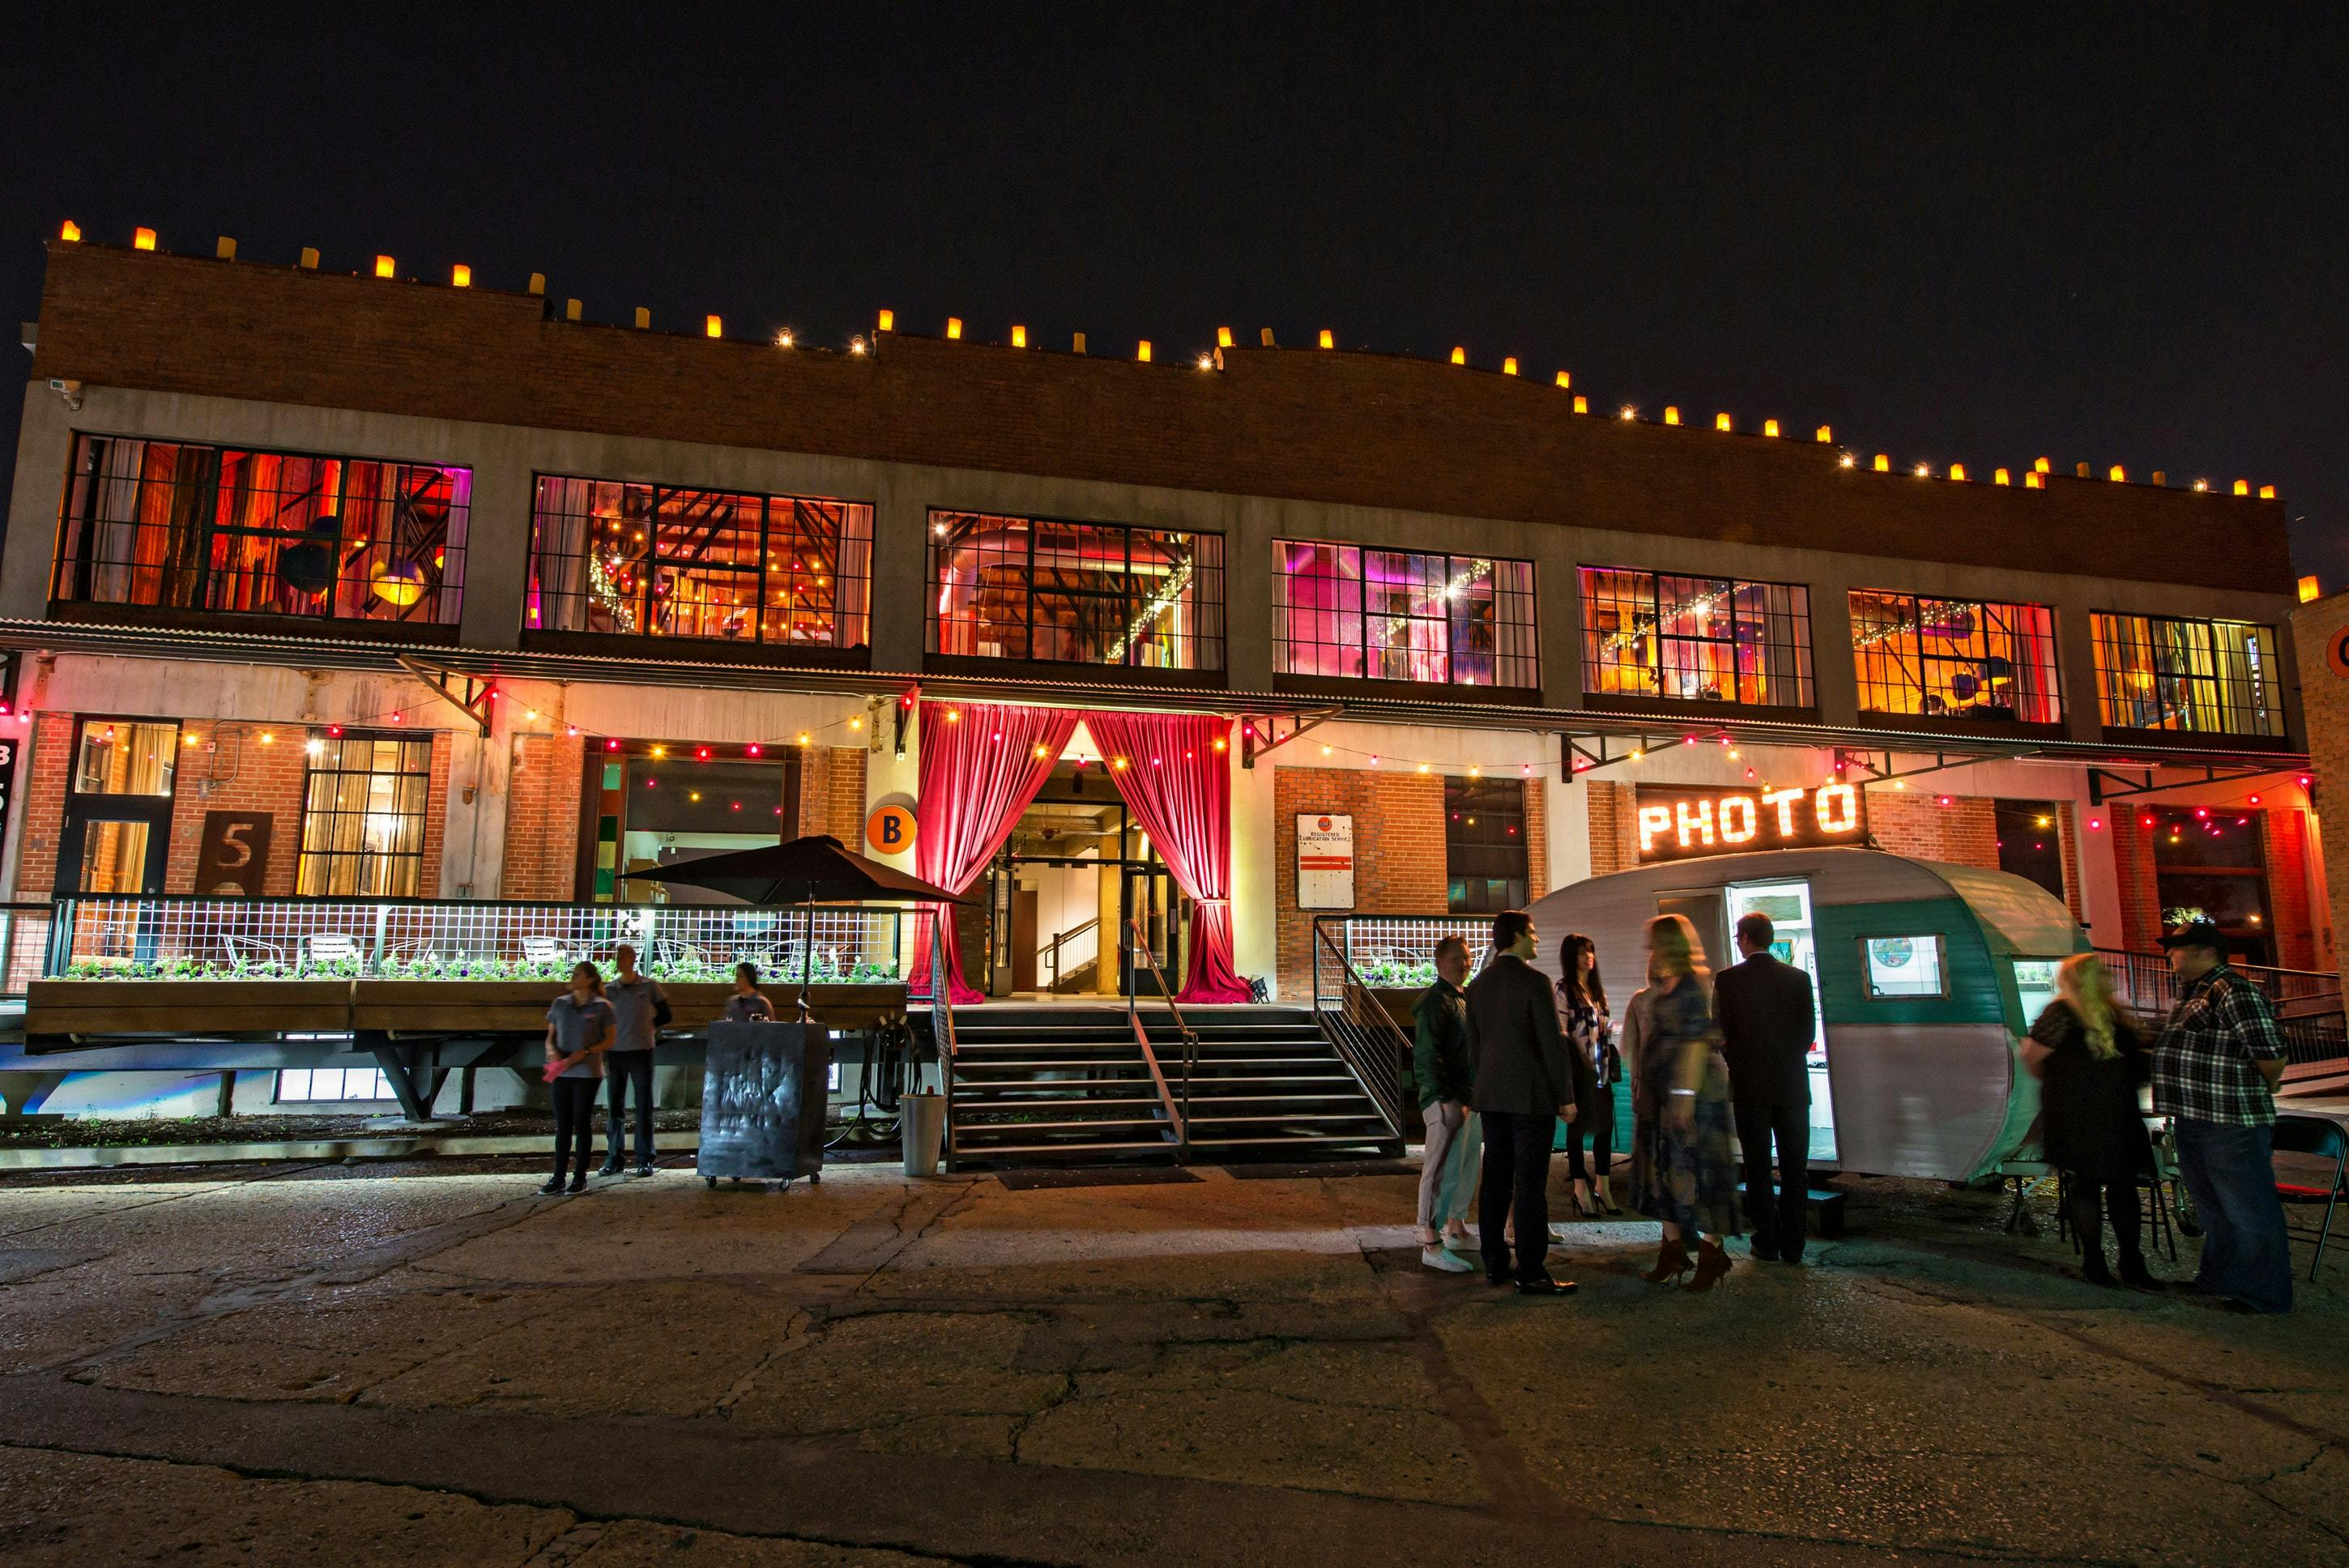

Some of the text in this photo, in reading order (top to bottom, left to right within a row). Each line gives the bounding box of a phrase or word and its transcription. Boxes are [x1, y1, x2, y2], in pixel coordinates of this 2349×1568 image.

[883, 816, 902, 844] B
[1639, 784, 1857, 850] PHOTO
[215, 823, 254, 867] 5
